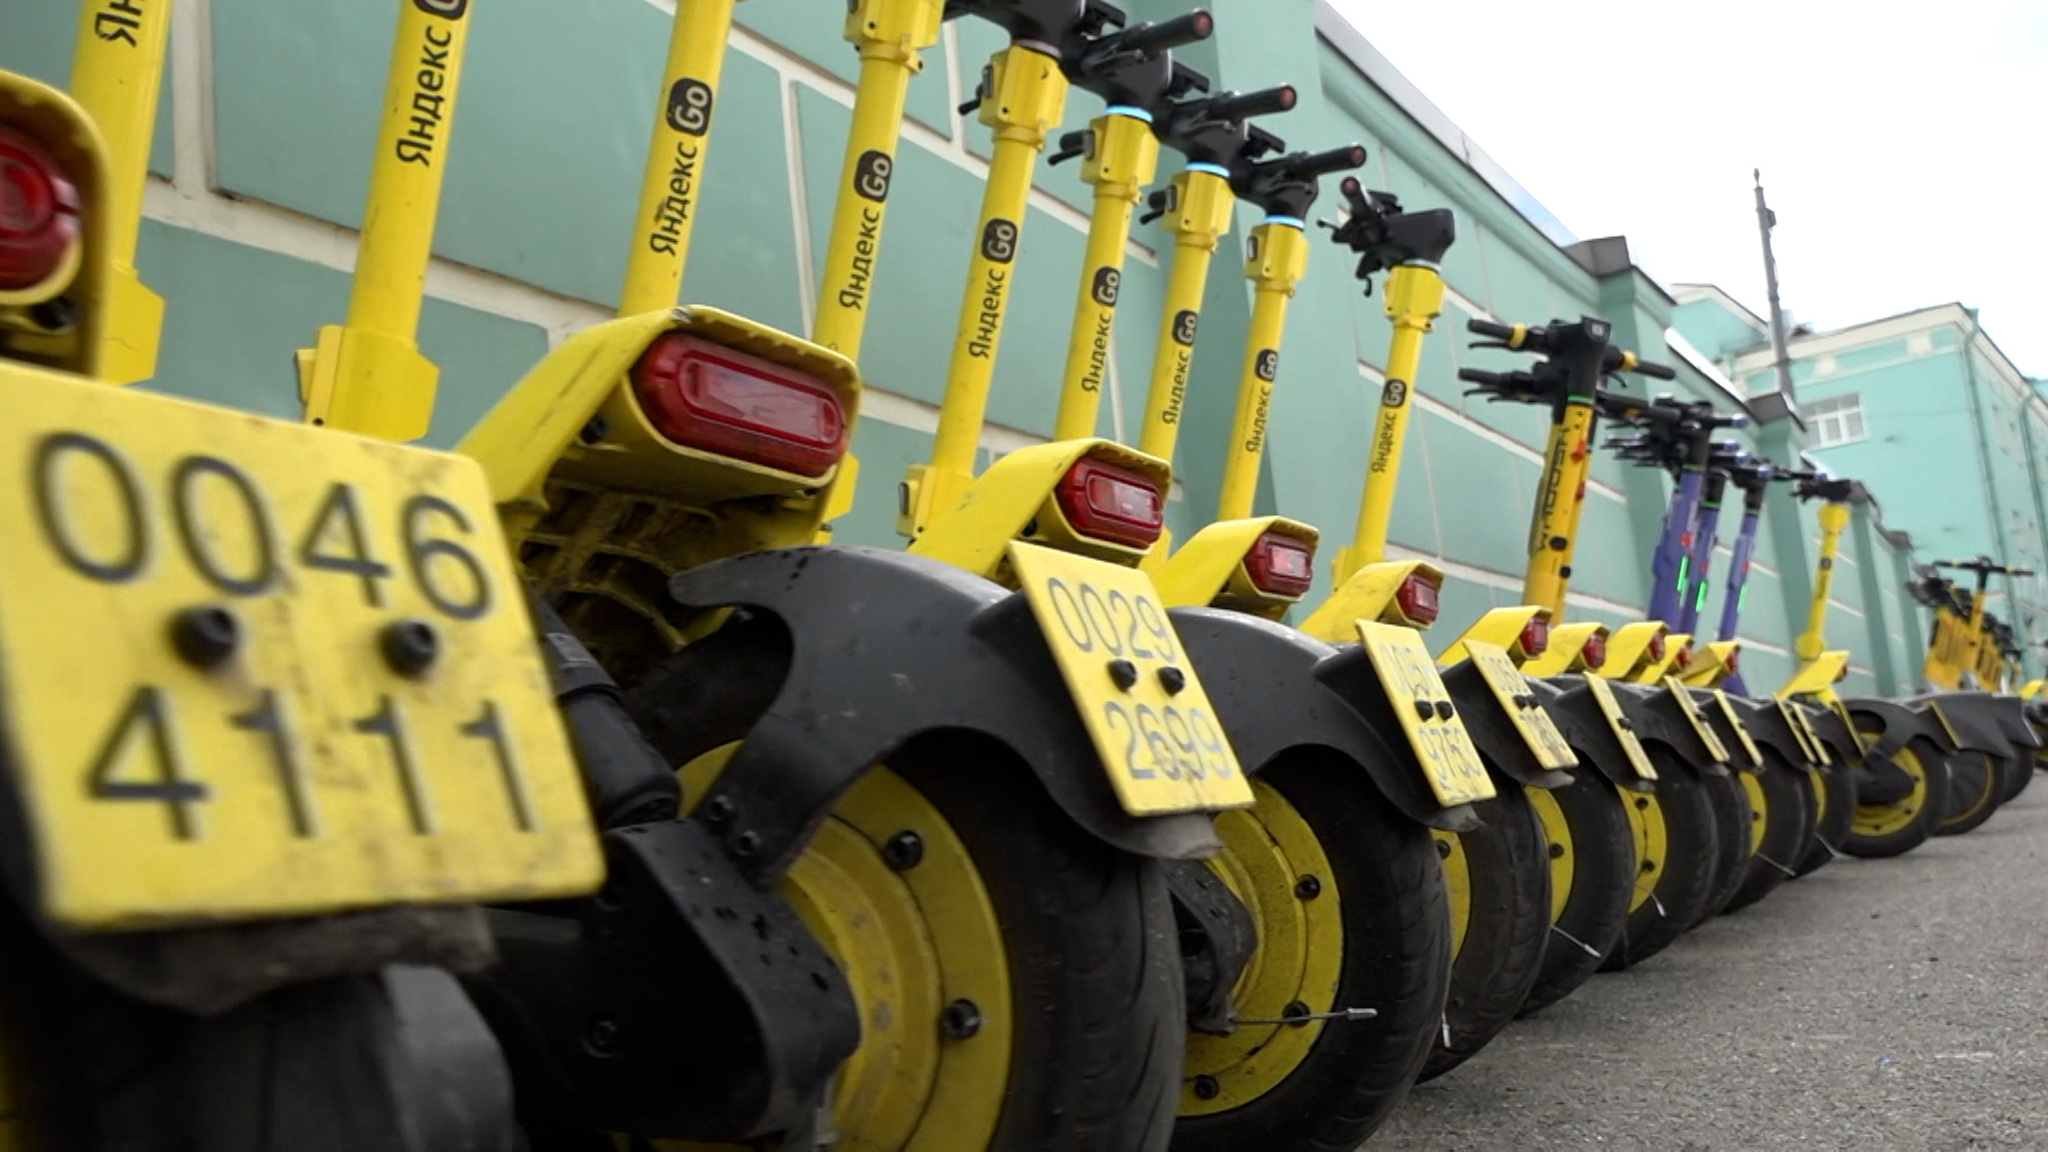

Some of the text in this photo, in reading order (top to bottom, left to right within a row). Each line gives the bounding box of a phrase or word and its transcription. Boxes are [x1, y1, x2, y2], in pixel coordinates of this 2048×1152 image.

[396, 25, 451, 168] Яндекс
[651, 85, 709, 256] Яндекс Go
[839, 157, 890, 311] Яндекс Go
[969, 224, 1016, 358] Яндекс Go
[1081, 271, 1119, 393] Яндекс Go
[1162, 314, 1197, 425] Яндекс Go
[1245, 352, 1278, 453] Яндекс Go
[1370, 381, 1404, 474] Яндекс Go
[30, 431, 493, 620] 0046
[1048, 577, 1176, 661] 0029
[87, 685, 539, 842] 4111
[1105, 702, 1230, 780] 2699
